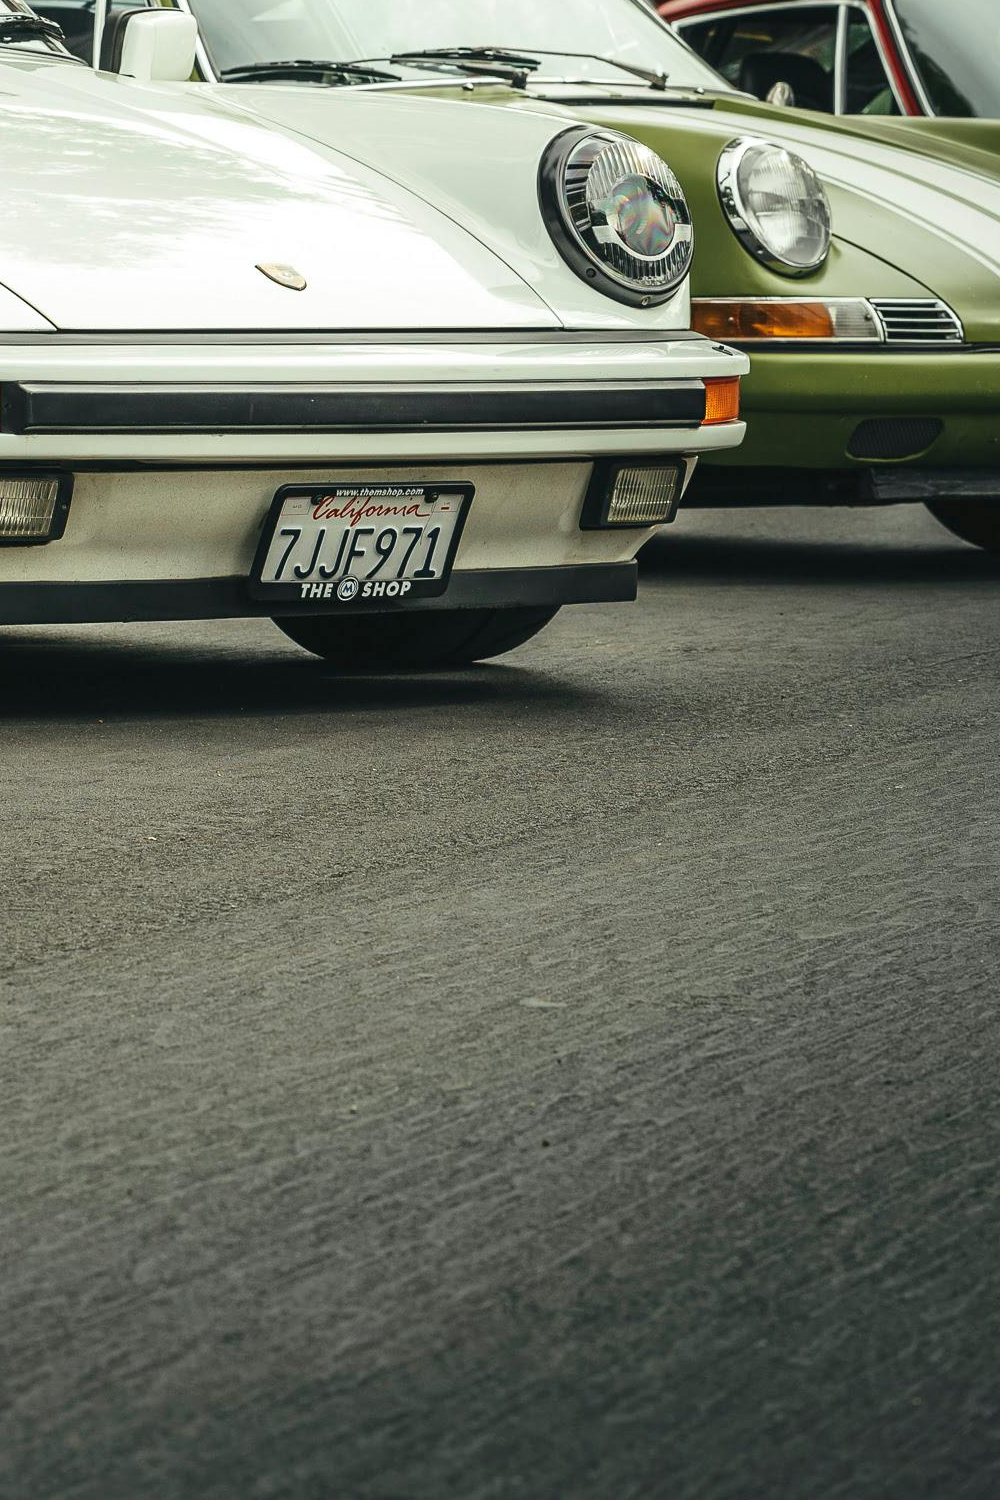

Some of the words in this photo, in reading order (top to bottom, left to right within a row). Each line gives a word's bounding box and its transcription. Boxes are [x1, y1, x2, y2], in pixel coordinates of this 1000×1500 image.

[336, 487, 424, 497] www.themshop.com
[312, 496, 430, 527] California
[274, 527, 441, 580] 7JJF971
[301, 583, 334, 598] THE
[361, 581, 412, 597] SHOP
